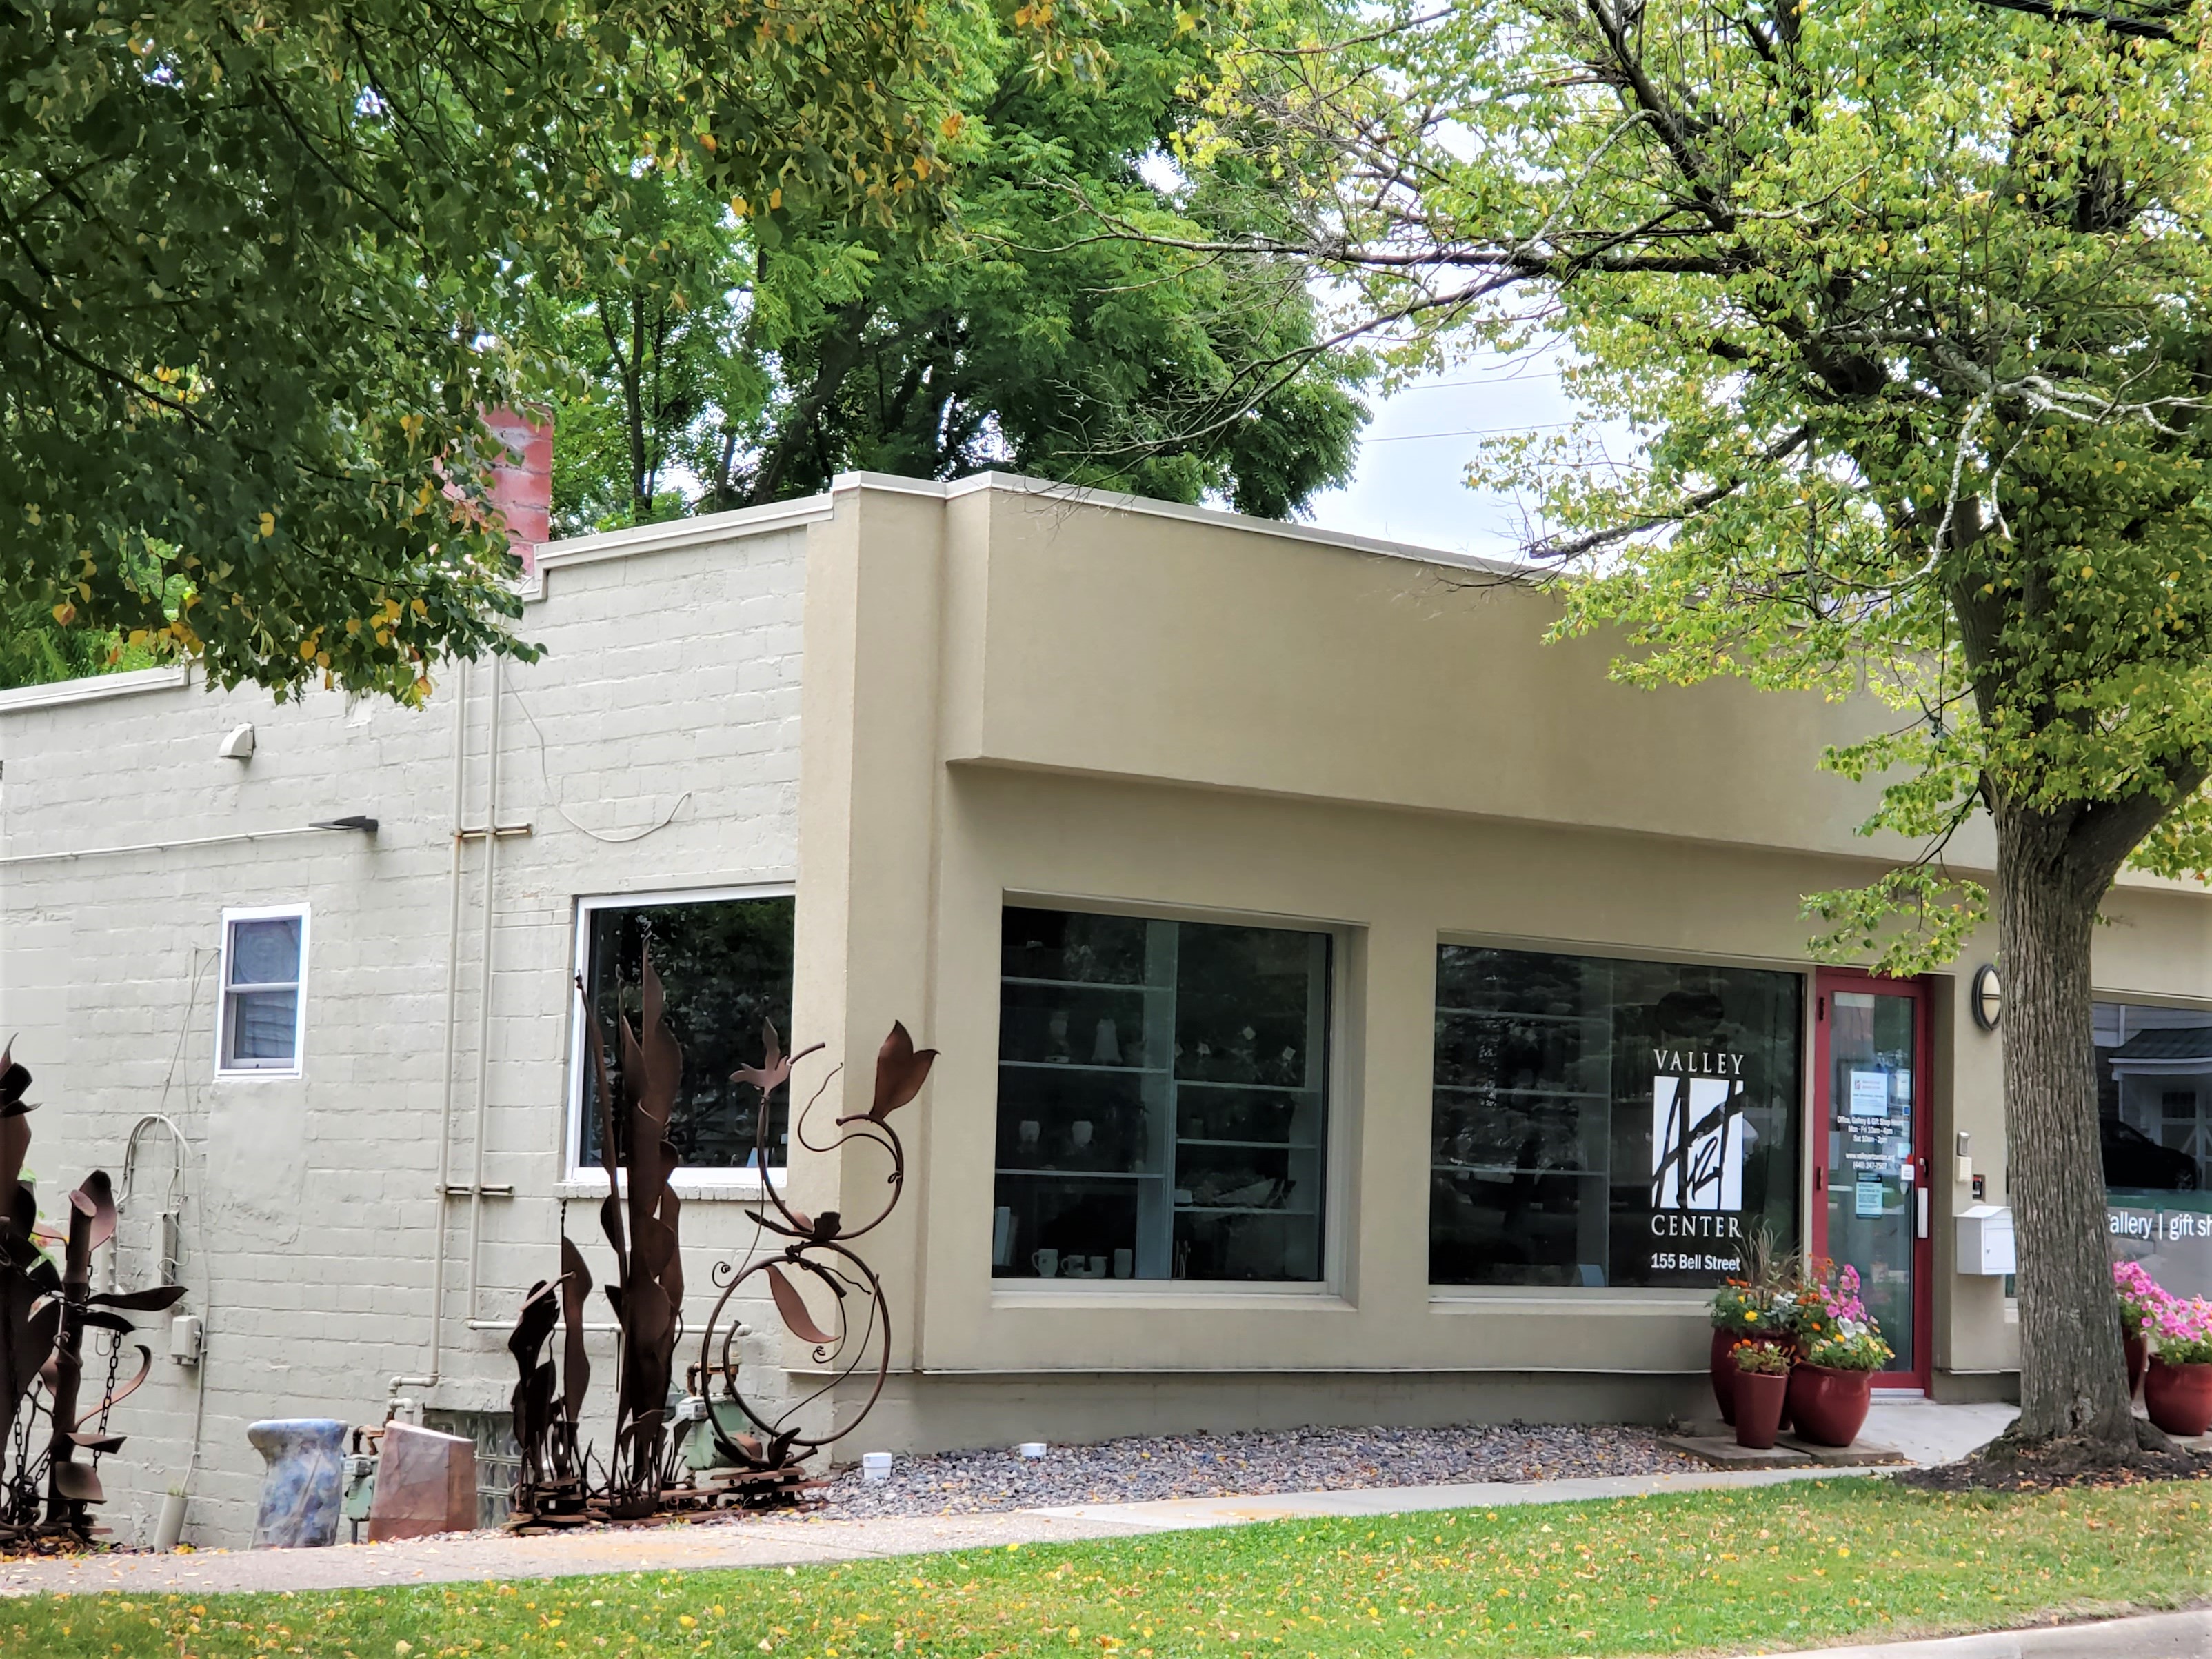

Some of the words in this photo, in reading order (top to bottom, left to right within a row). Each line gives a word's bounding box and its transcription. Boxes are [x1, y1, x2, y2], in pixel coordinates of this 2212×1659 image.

[1653, 1049, 1745, 1075] VALLEY
[1651, 1214, 1743, 1238] CENTER
[2107, 1211, 2153, 1240] allery
[2169, 1214, 2195, 1241] gift
[1651, 1253, 1676, 1269] 155
[1679, 1254, 1701, 1269] Bell
[1704, 1254, 1741, 1271] Street
